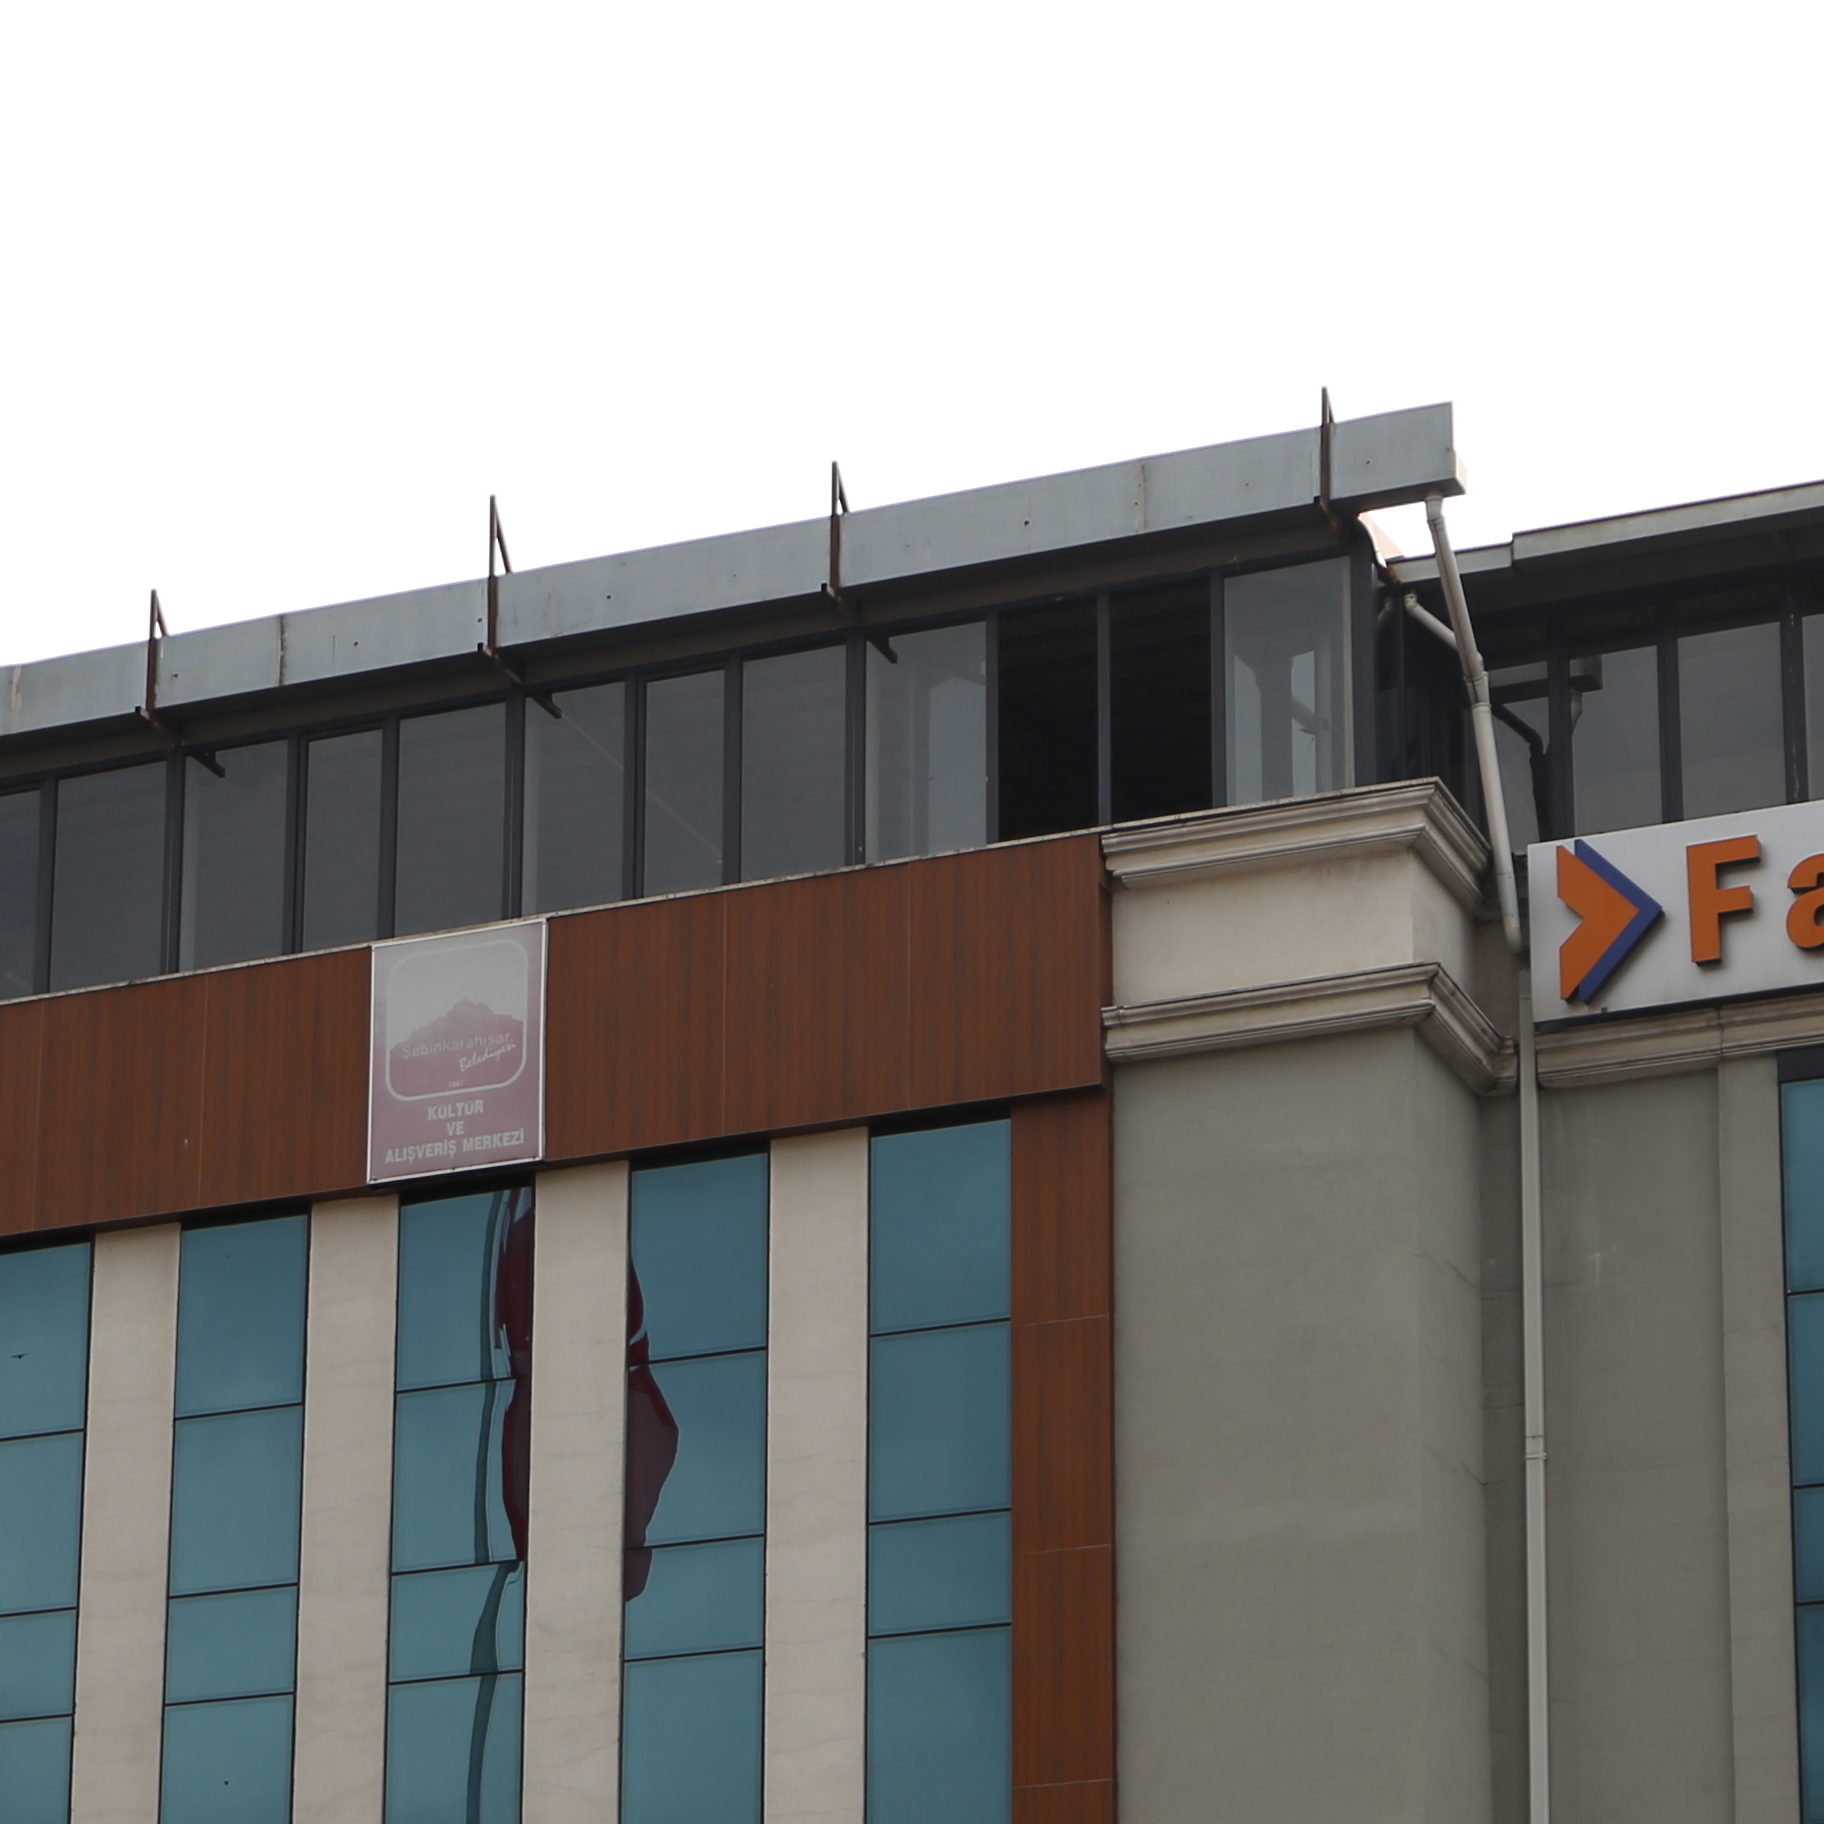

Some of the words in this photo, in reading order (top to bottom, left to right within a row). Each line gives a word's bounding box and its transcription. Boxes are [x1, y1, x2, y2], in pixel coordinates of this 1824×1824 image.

[446, 1120, 465, 1137] VE
[385, 1138, 457, 1164] ALIŞVERİŞ
[463, 1127, 524, 1154] MERKEZİ
